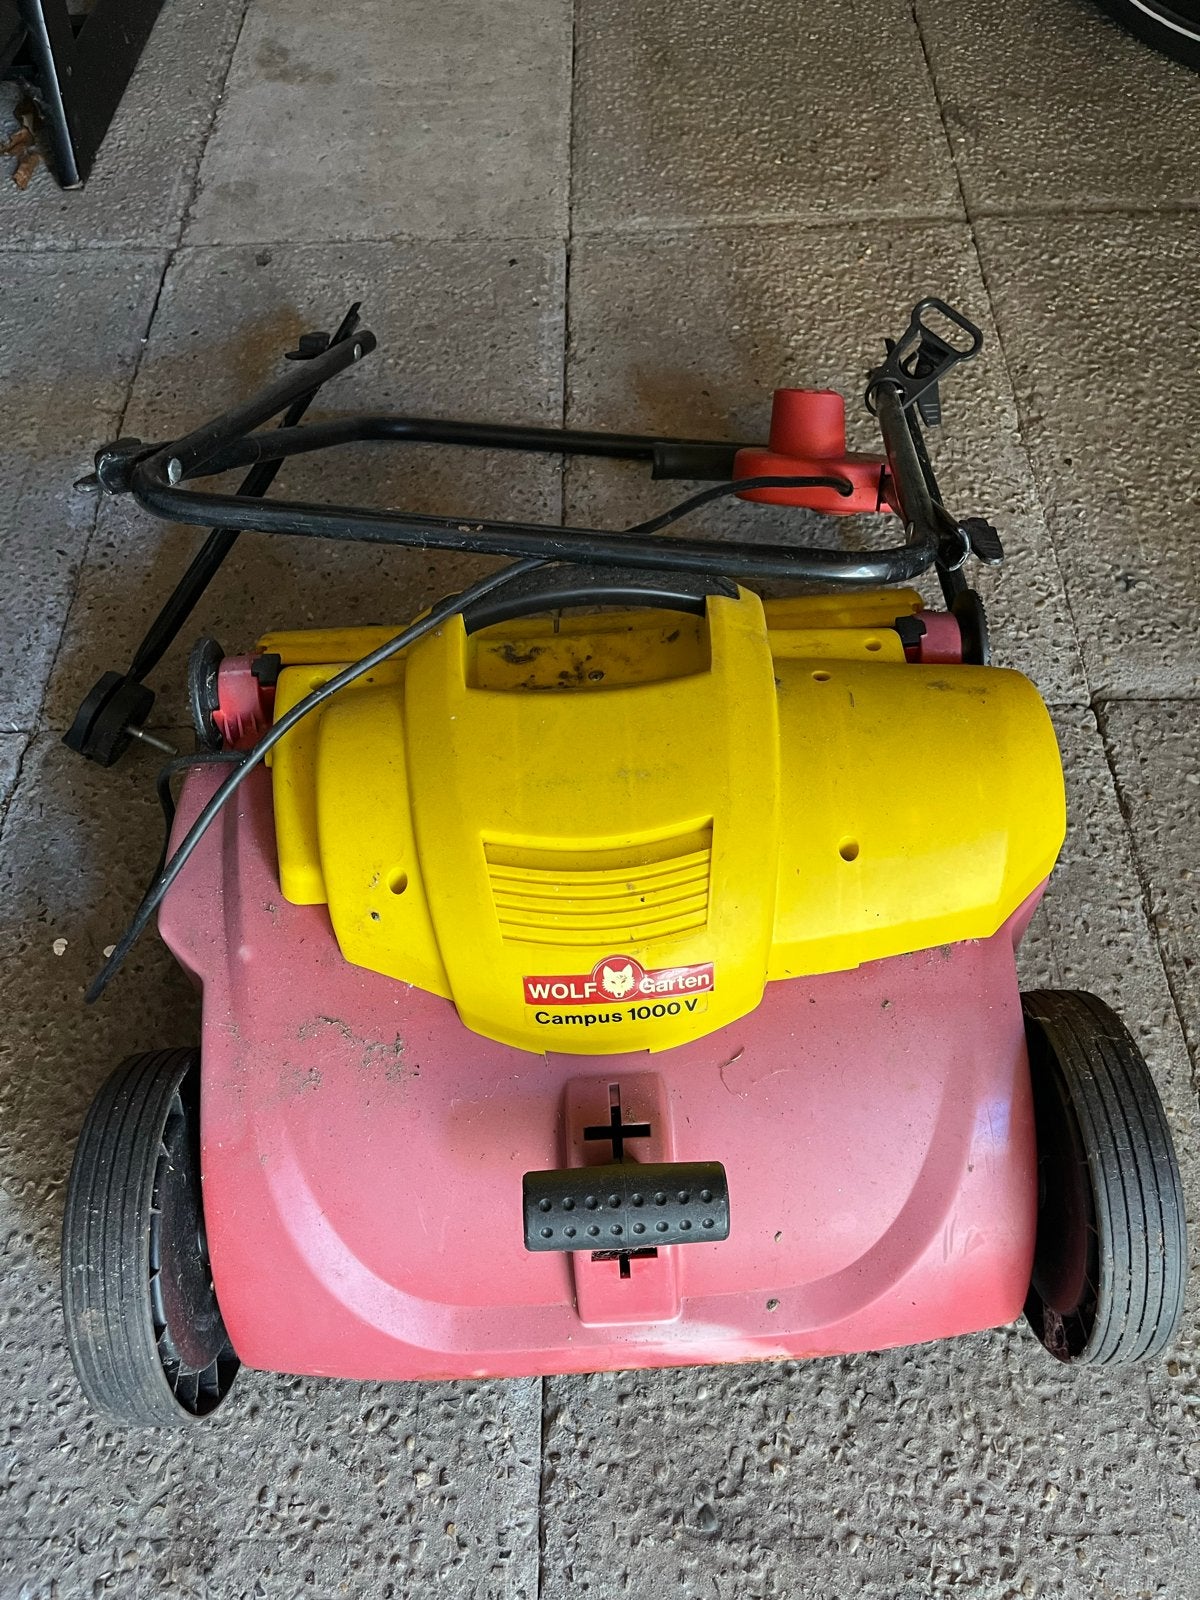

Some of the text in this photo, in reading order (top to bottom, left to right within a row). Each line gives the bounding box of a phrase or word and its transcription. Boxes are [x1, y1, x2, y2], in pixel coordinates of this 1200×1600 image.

[527, 972, 710, 999] WOLF Garten
[535, 998, 698, 1026] Campus 1000 V
